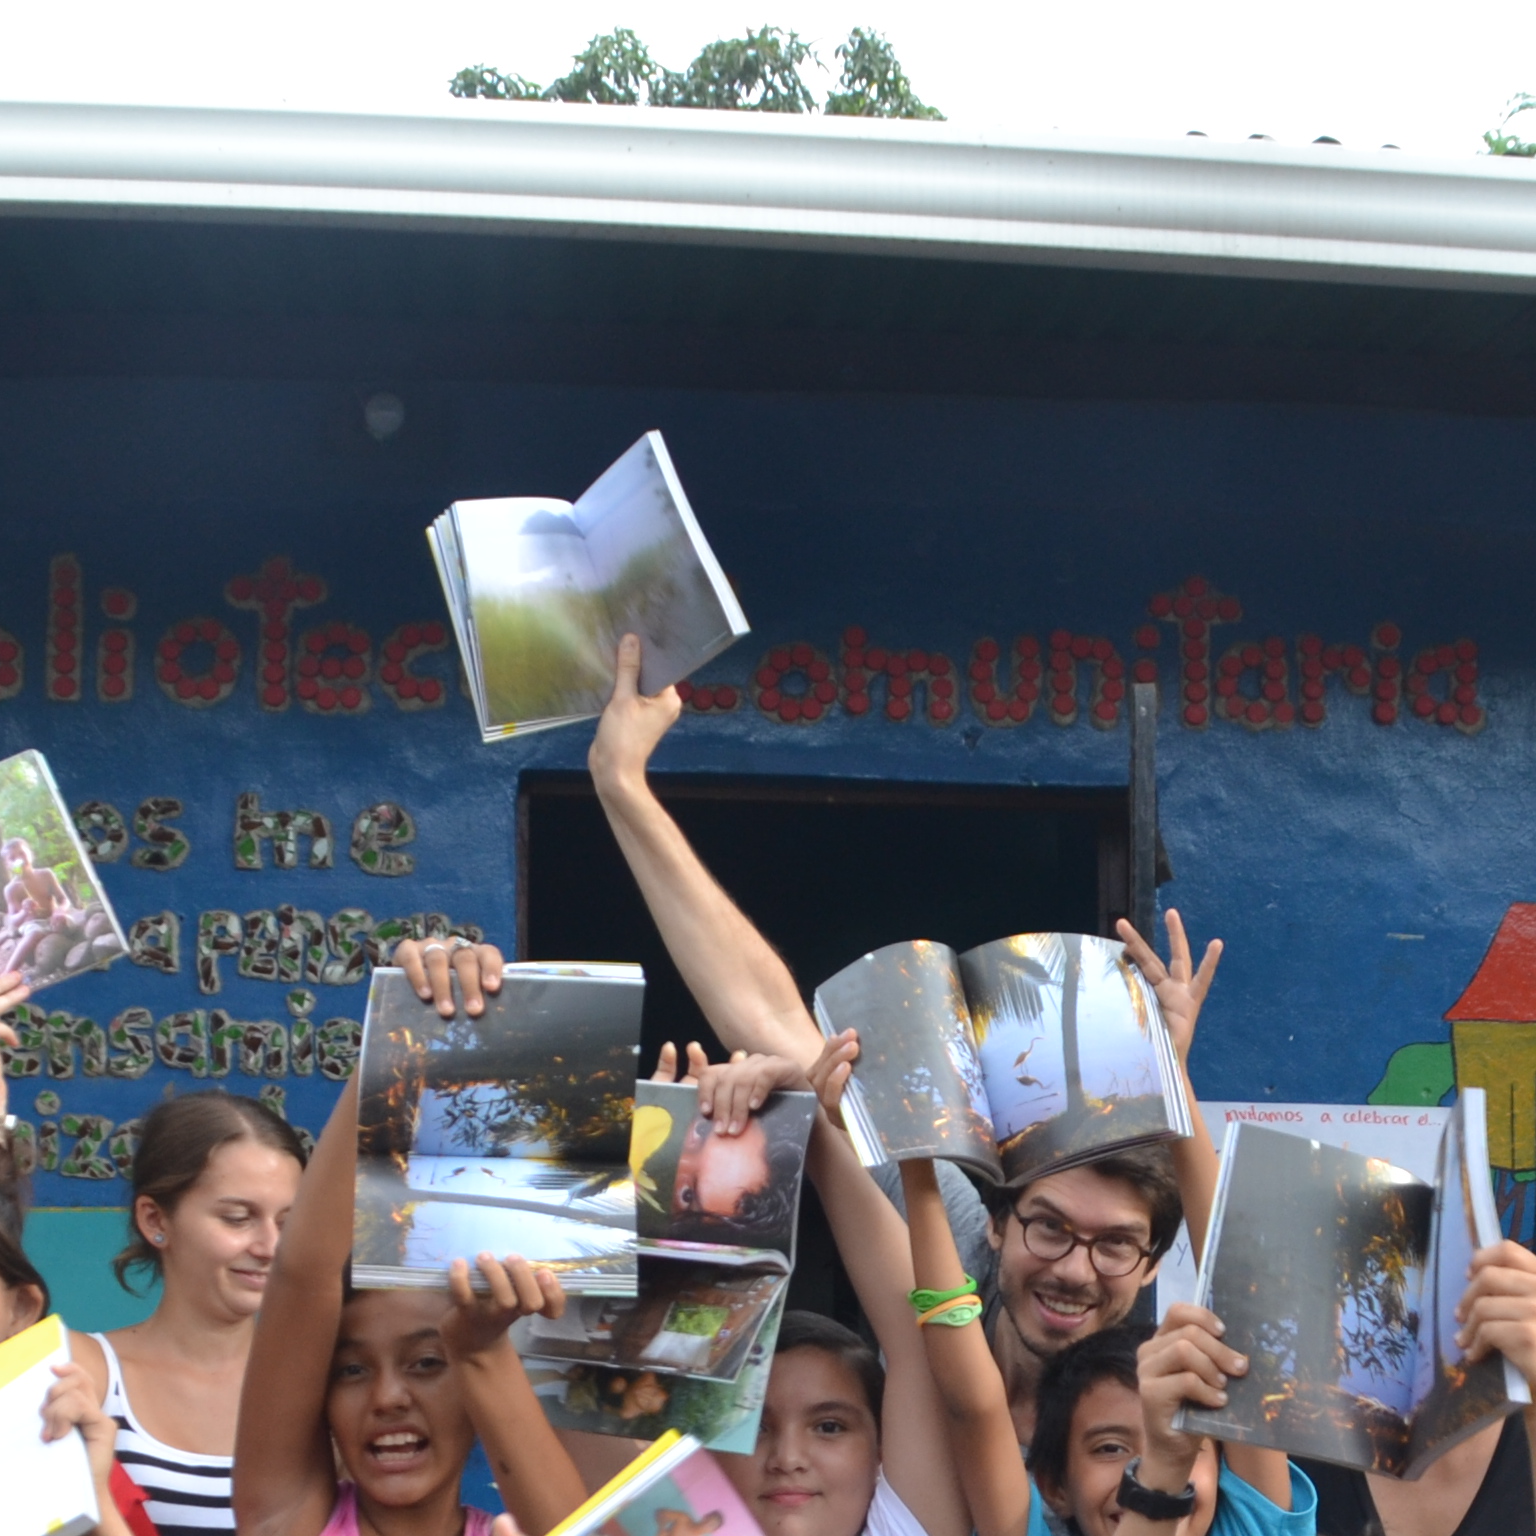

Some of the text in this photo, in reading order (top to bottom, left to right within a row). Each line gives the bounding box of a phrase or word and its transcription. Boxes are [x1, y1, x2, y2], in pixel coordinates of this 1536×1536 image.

[234, 791, 417, 877] me
[128, 909, 181, 974] a
[1320, 1111, 1333, 1123] a
[1342, 1109, 1411, 1127] celebrar
